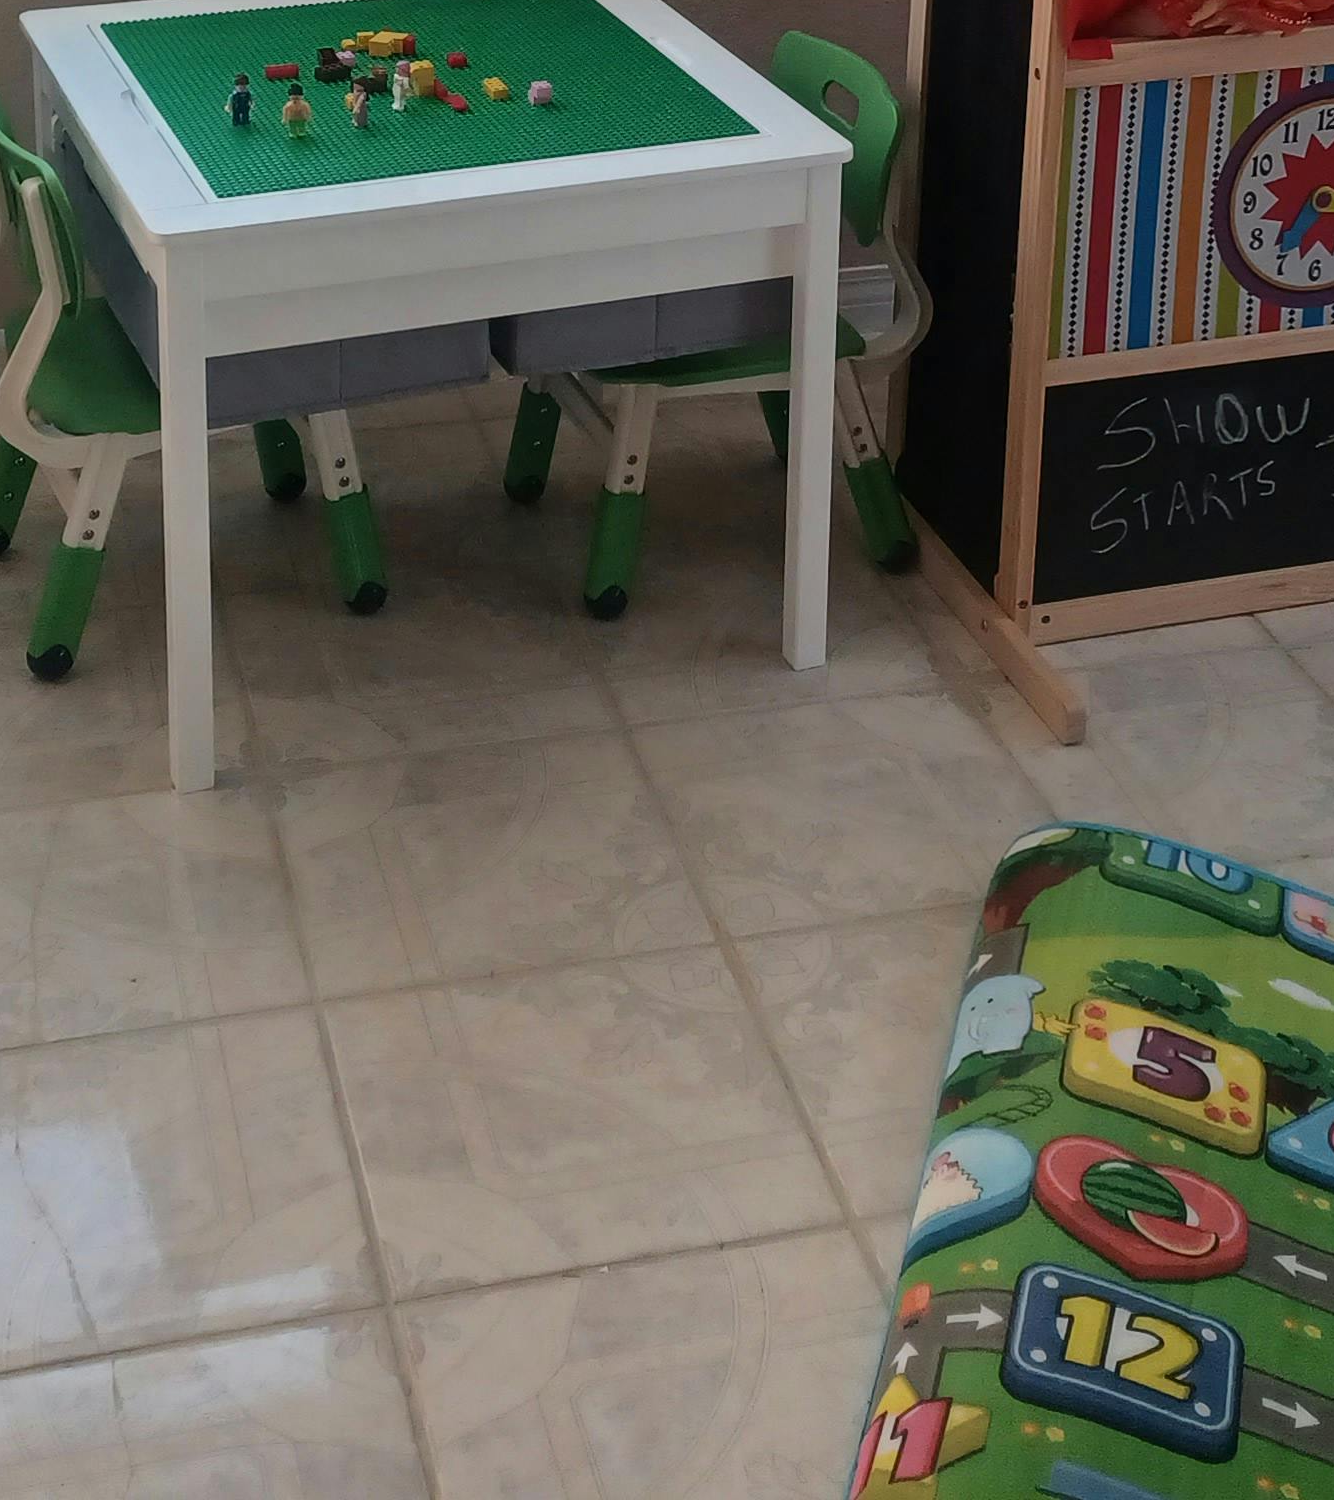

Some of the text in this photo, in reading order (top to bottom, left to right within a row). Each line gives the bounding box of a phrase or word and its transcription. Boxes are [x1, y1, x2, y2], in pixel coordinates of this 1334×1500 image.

[1282, 121, 1299, 144] 11
[1251, 154, 1273, 177] 10
[1243, 191, 1257, 214] 9
[1249, 228, 1264, 250] 8
[1276, 254, 1289, 276] 7
[1308, 259, 1321, 281] 6
[1096, 392, 1310, 471] SHOW
[1090, 460, 1276, 554] STARTS
[1131, 1024, 1218, 1103] 5
[1056, 1294, 1203, 1402] 12
